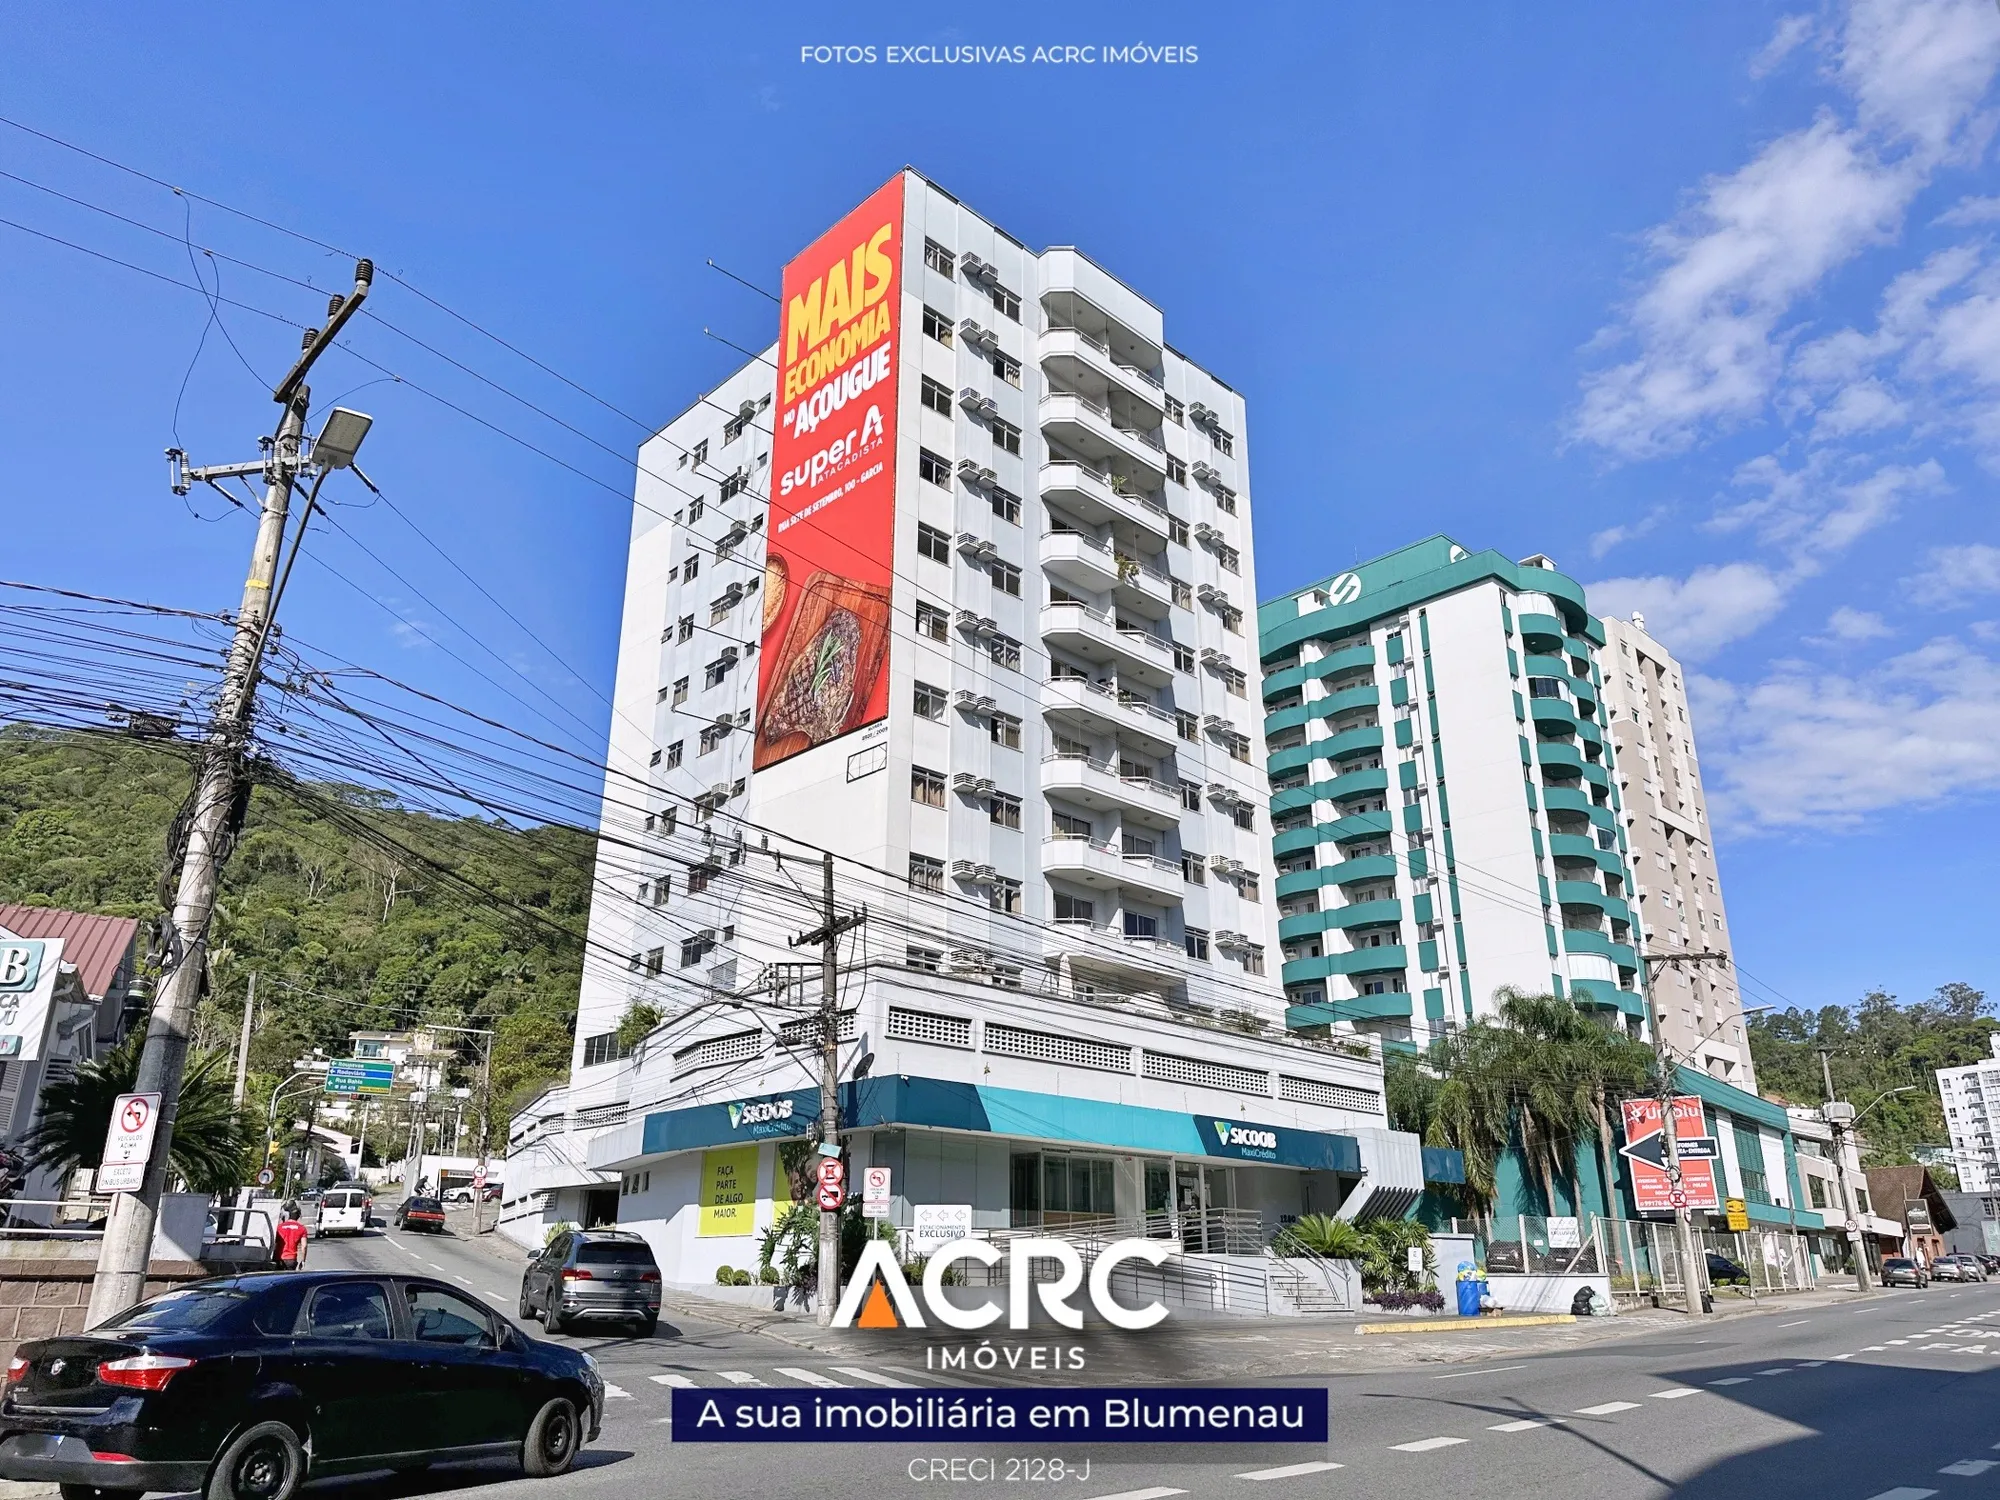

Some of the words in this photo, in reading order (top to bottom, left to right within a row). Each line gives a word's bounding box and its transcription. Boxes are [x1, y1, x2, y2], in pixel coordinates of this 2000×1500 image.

[786, 223, 893, 367] MAIS
[784, 299, 891, 406] ECONOMIA
[783, 408, 796, 429] NO
[793, 341, 891, 439] AÇOUGUE
[780, 429, 857, 496] super
[860, 404, 885, 447] A
[818, 437, 883, 485] ATACADISTA
[777, 519, 790, 533] RUA
[790, 510, 804, 526] SETE
[804, 505, 812, 518] DE
[860, 461, 883, 483] GARCIA
[742, 1100, 793, 1125] SICOOB
[1230, 1127, 1277, 1149] SICOOB
[1241, 1147, 1276, 1160] MaxiCrédito
[717, 1165, 734, 1178] FAÇA
[716, 1179, 737, 1190] PARTE
[715, 1194, 724, 1204] DE
[725, 1192, 744, 1203] ALGO
[919, 1230, 966, 1239] EXCLUSIVO
